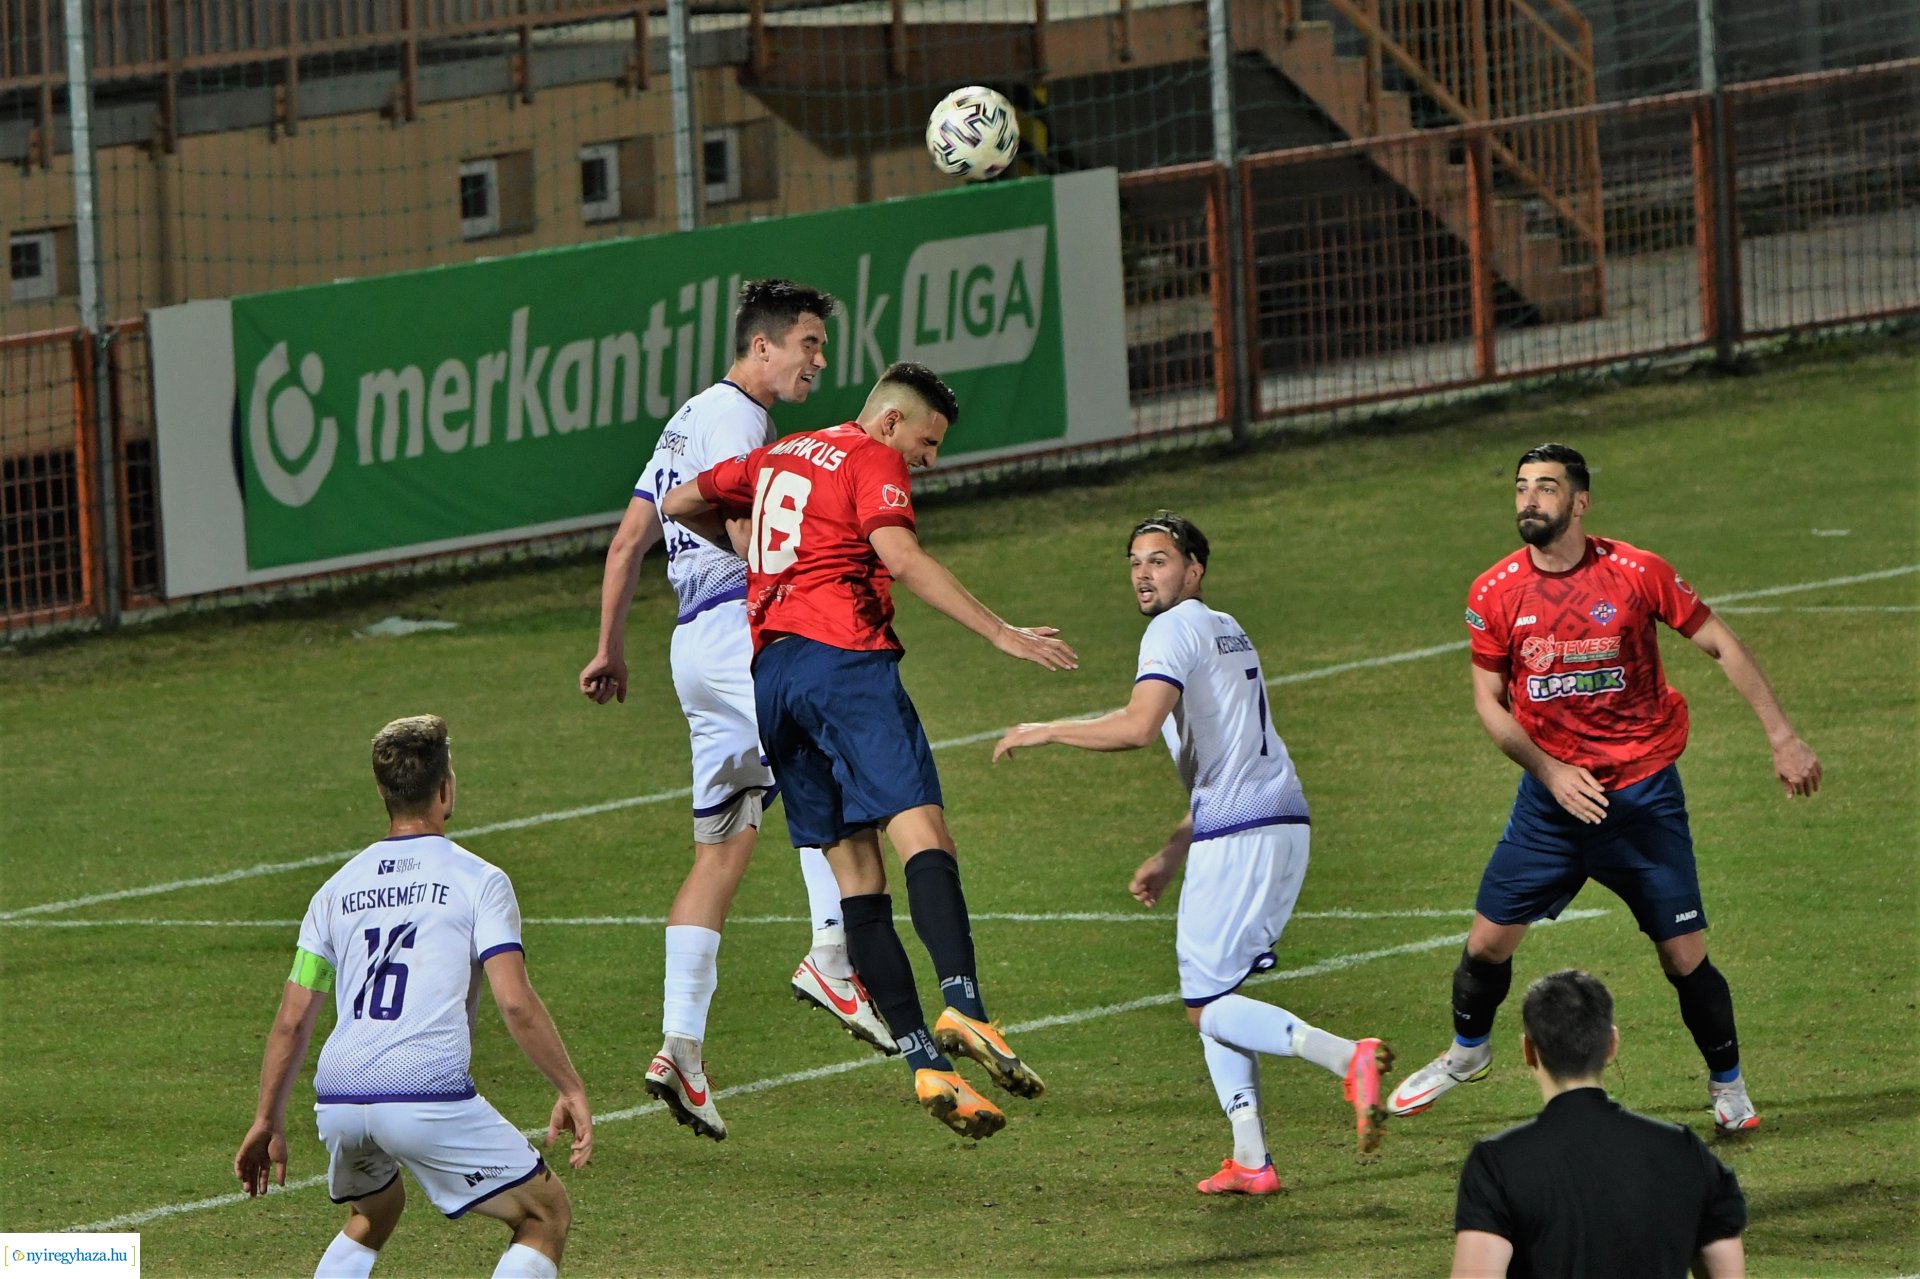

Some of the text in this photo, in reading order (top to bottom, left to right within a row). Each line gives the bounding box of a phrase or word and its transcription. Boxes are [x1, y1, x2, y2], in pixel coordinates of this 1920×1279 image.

[915, 258, 1035, 347] LIGA
[747, 467, 812, 575] 18
[1245, 667, 1268, 756] 7
[341, 882, 450, 915] KECSKEMÉTI TE
[1675, 910, 1698, 923] JAKO
[354, 922, 417, 1021] 16
